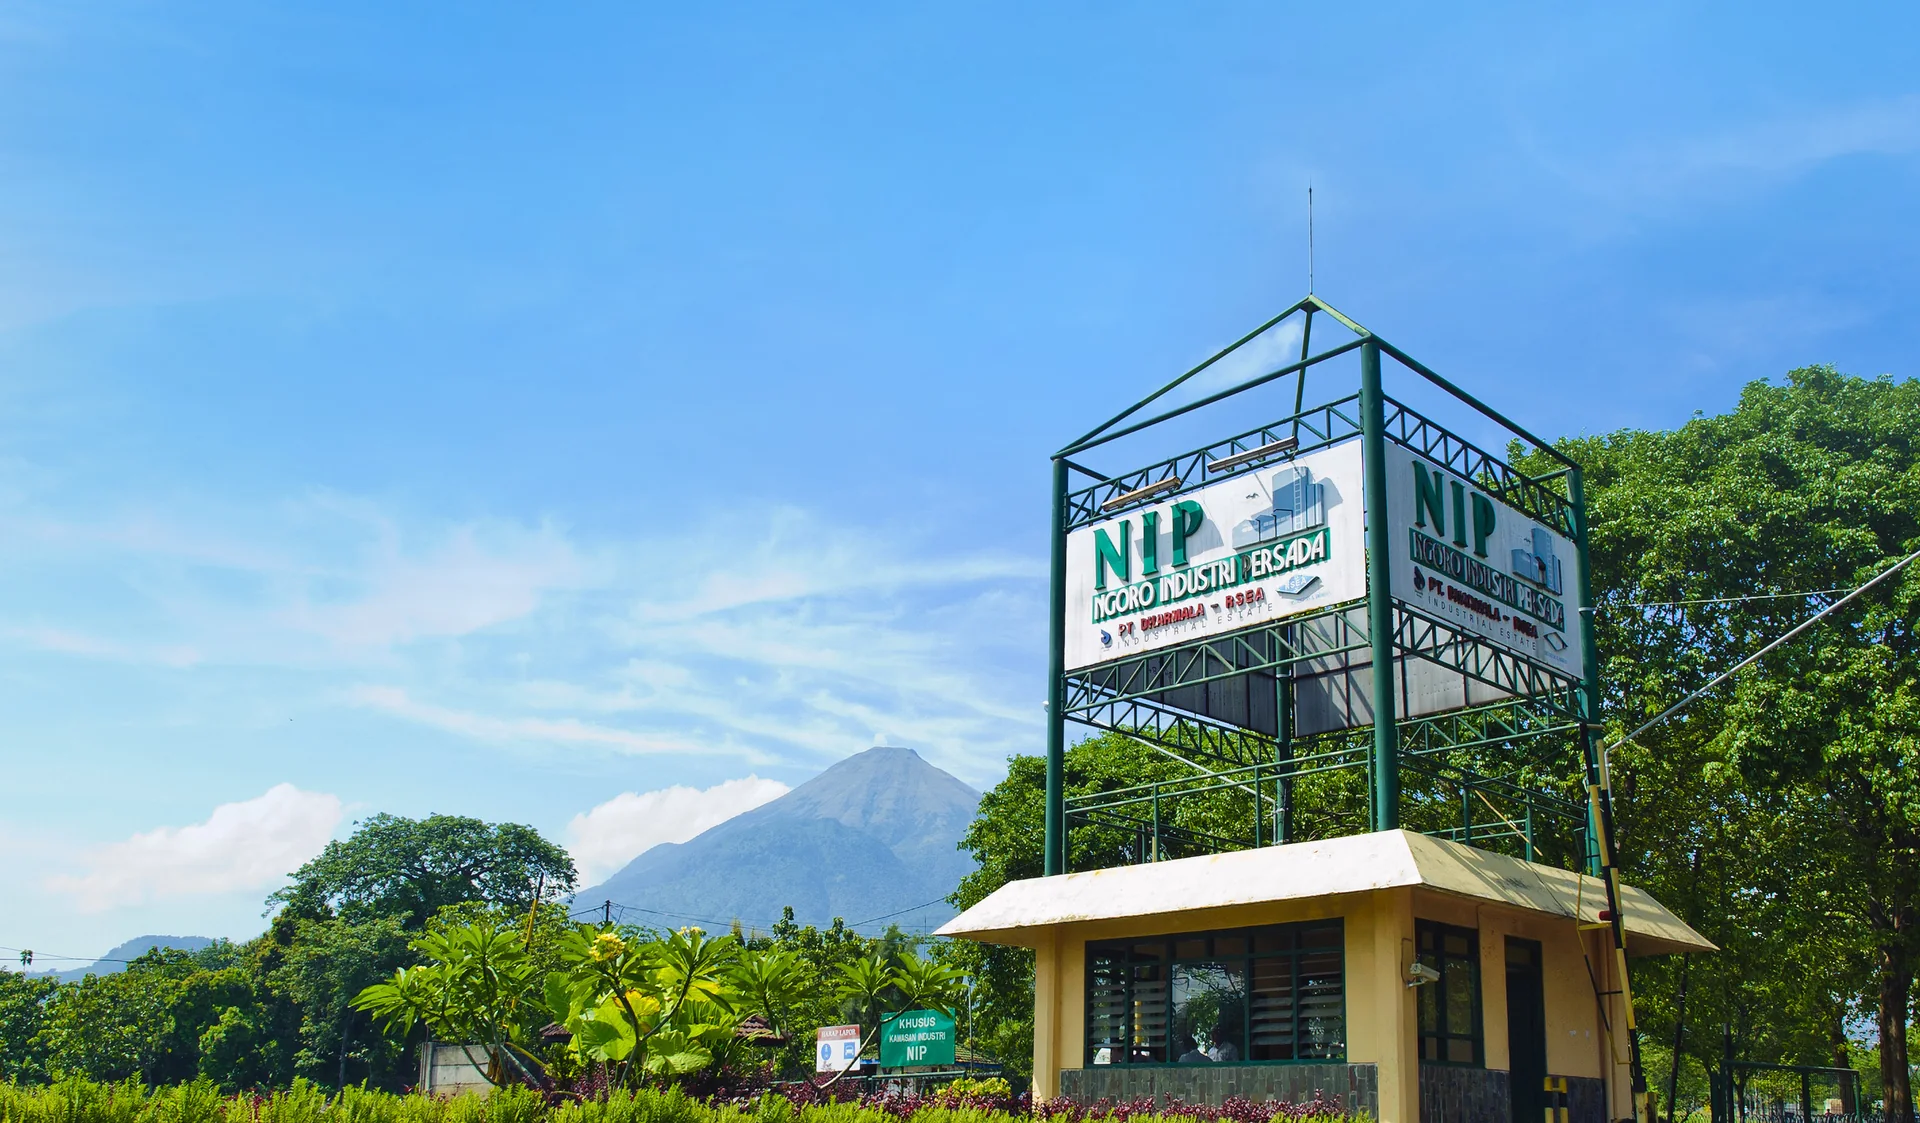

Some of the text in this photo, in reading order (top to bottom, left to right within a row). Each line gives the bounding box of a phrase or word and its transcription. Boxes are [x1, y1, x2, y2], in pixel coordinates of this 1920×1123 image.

[1412, 460, 1496, 559] NIP
[1093, 499, 1204, 591] NIP
[1094, 531, 1326, 620] NGORO INDUSTRI PERSADA
[1413, 531, 1564, 630] NGORO INDUSTRI PERSADA
[1117, 602, 1273, 650] INDUSTRIAL ESTATE
[1118, 621, 1134, 636] PT
[1141, 603, 1205, 631] DHARMALA
[1225, 587, 1264, 609] RSEA
[1428, 597, 1537, 651] INDUSTRIAL ESTATE
[840, 1028, 856, 1036] LAPOR
[889, 1033, 946, 1043] KAWASAN INDUSTRI
[899, 1016, 936, 1029] KHUSUS
[906, 1045, 927, 1061] NIP
